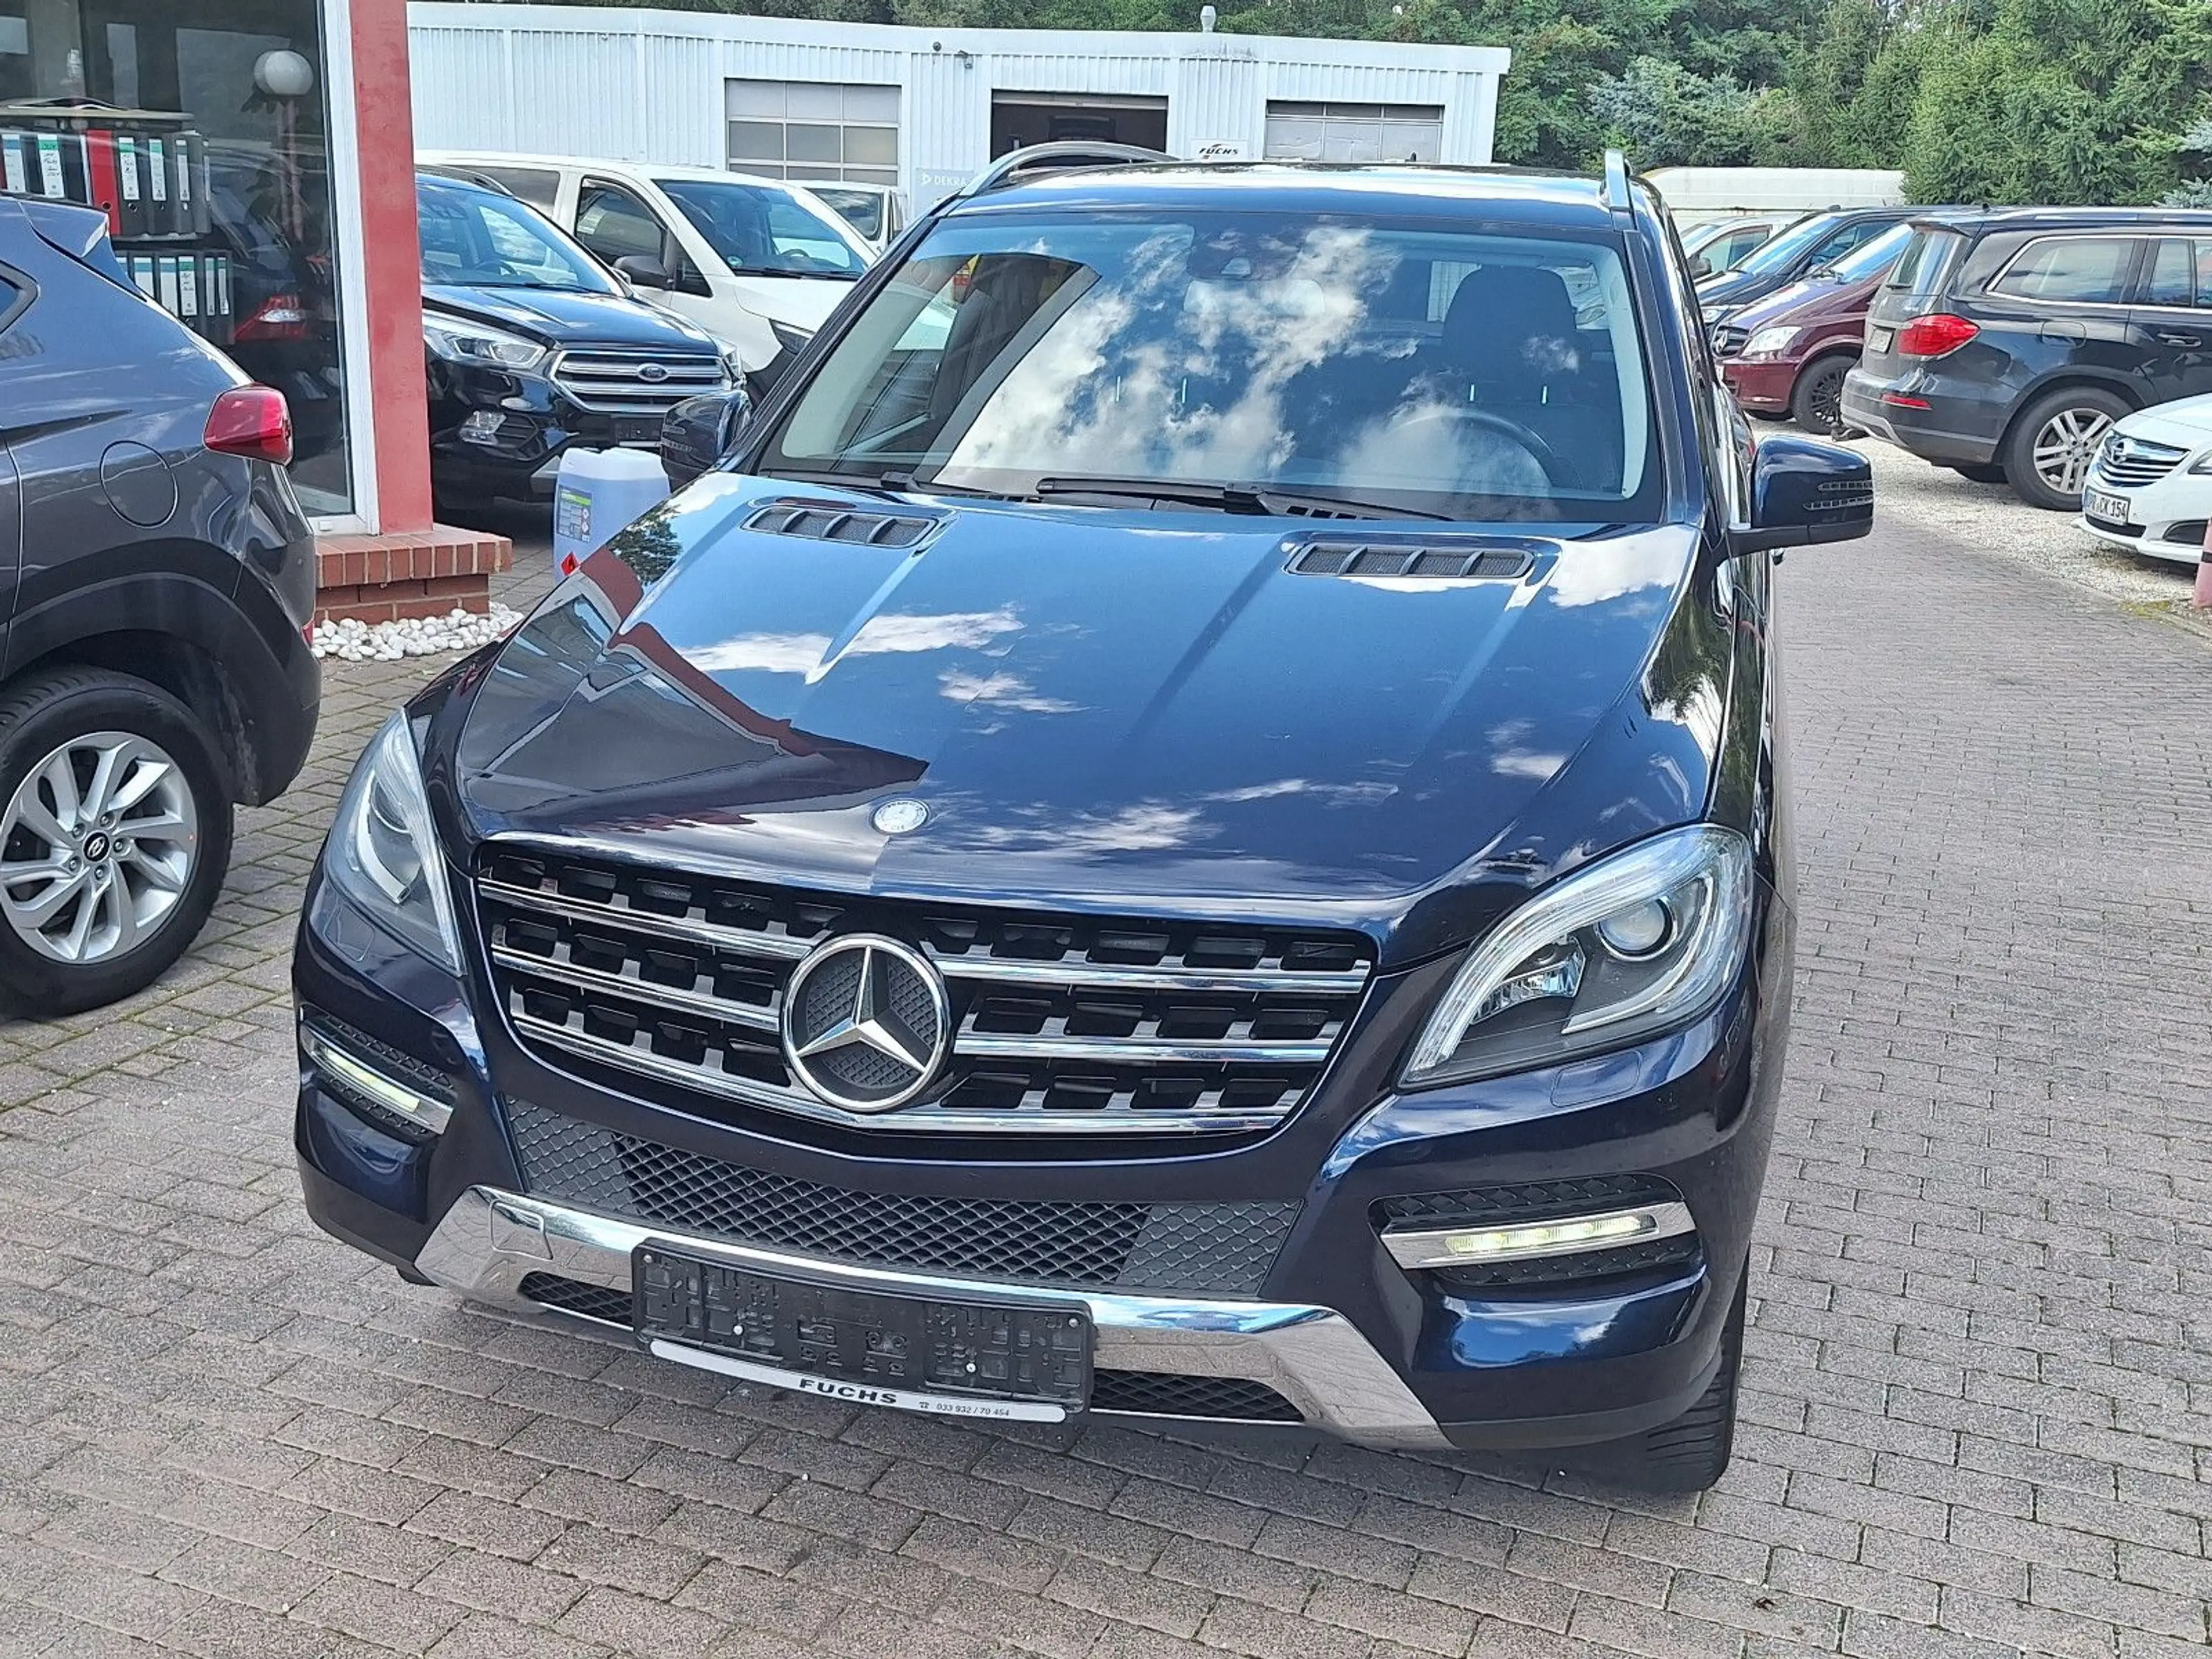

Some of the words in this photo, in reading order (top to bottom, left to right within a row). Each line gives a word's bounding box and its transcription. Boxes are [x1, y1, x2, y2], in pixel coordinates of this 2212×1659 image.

[934, 175, 967, 187] DEKRA
[799, 1377, 897, 1404] FUCHS
[936, 1403, 953, 1412] 033
[955, 1405, 971, 1414] 932
[980, 1407, 991, 1415] 70
